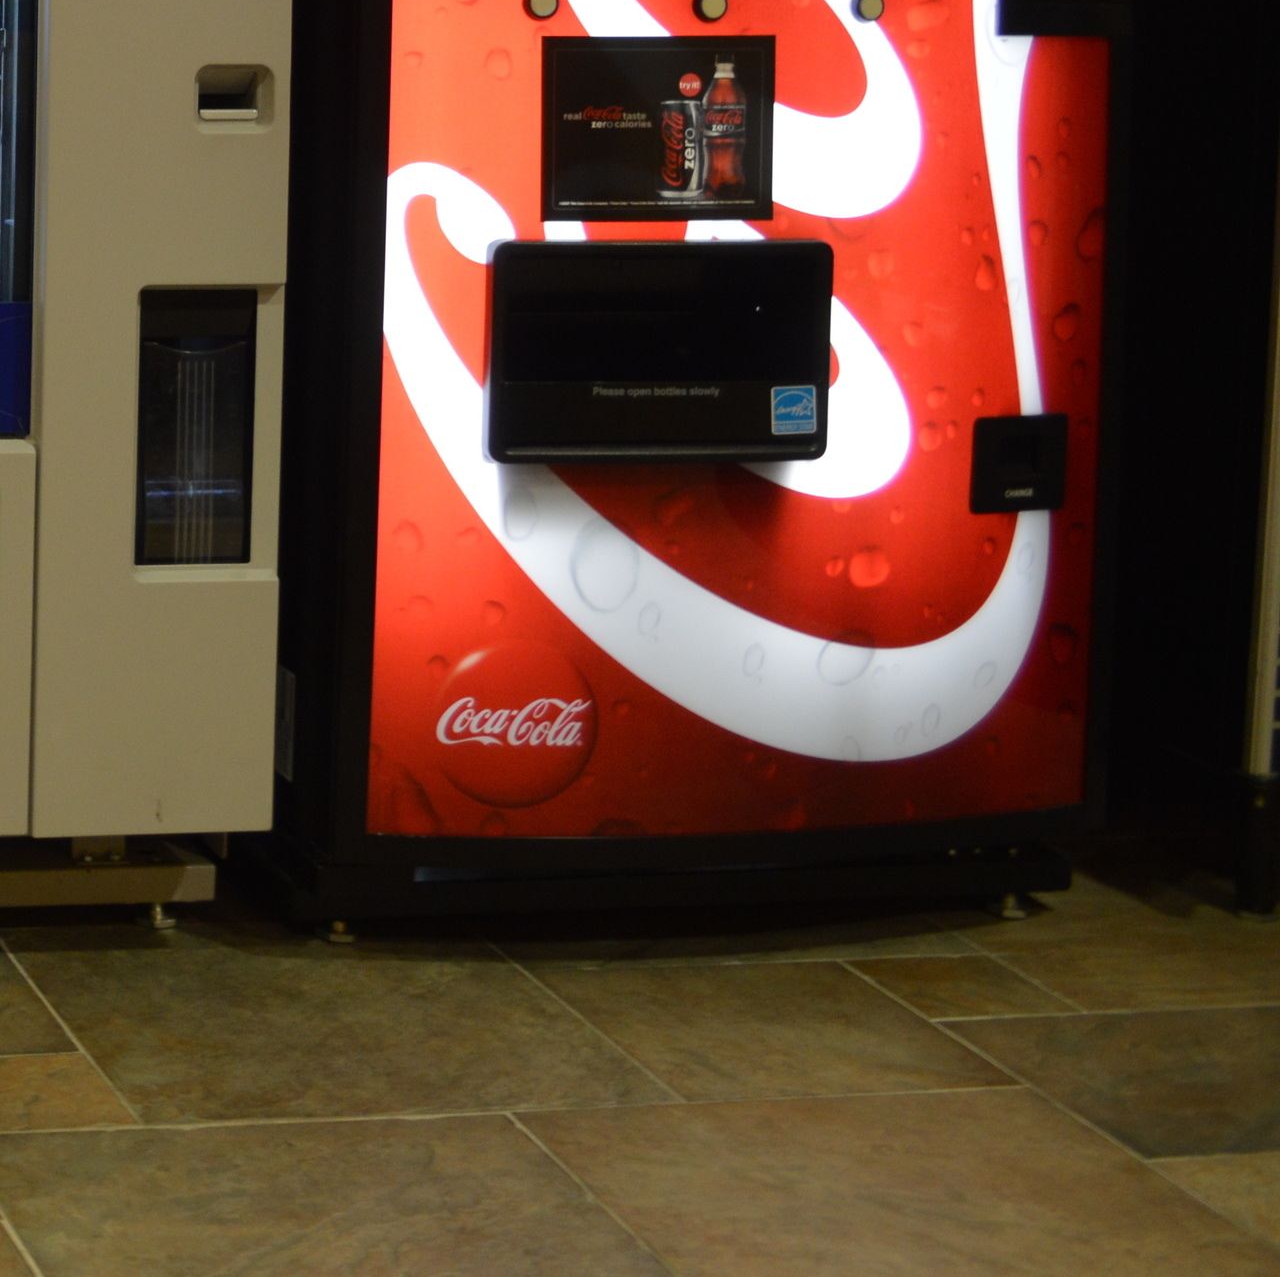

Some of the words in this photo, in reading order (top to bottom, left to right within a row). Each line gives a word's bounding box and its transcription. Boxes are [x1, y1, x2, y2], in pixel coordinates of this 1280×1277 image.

[679, 82, 690, 90] try
[563, 112, 582, 121] real
[582, 106, 624, 121] Coca-Cola
[623, 112, 646, 121] taste
[591, 120, 614, 129] zero
[614, 120, 652, 128] calories
[711, 123, 735, 132] zero
[663, 111, 684, 187] Coca-Cola
[684, 127, 696, 170] zero
[592, 386, 625, 396] Please
[627, 388, 651, 398] open
[653, 386, 687, 397] bottles
[689, 386, 720, 398] slowly
[435, 696, 592, 746] Coca-Cola
